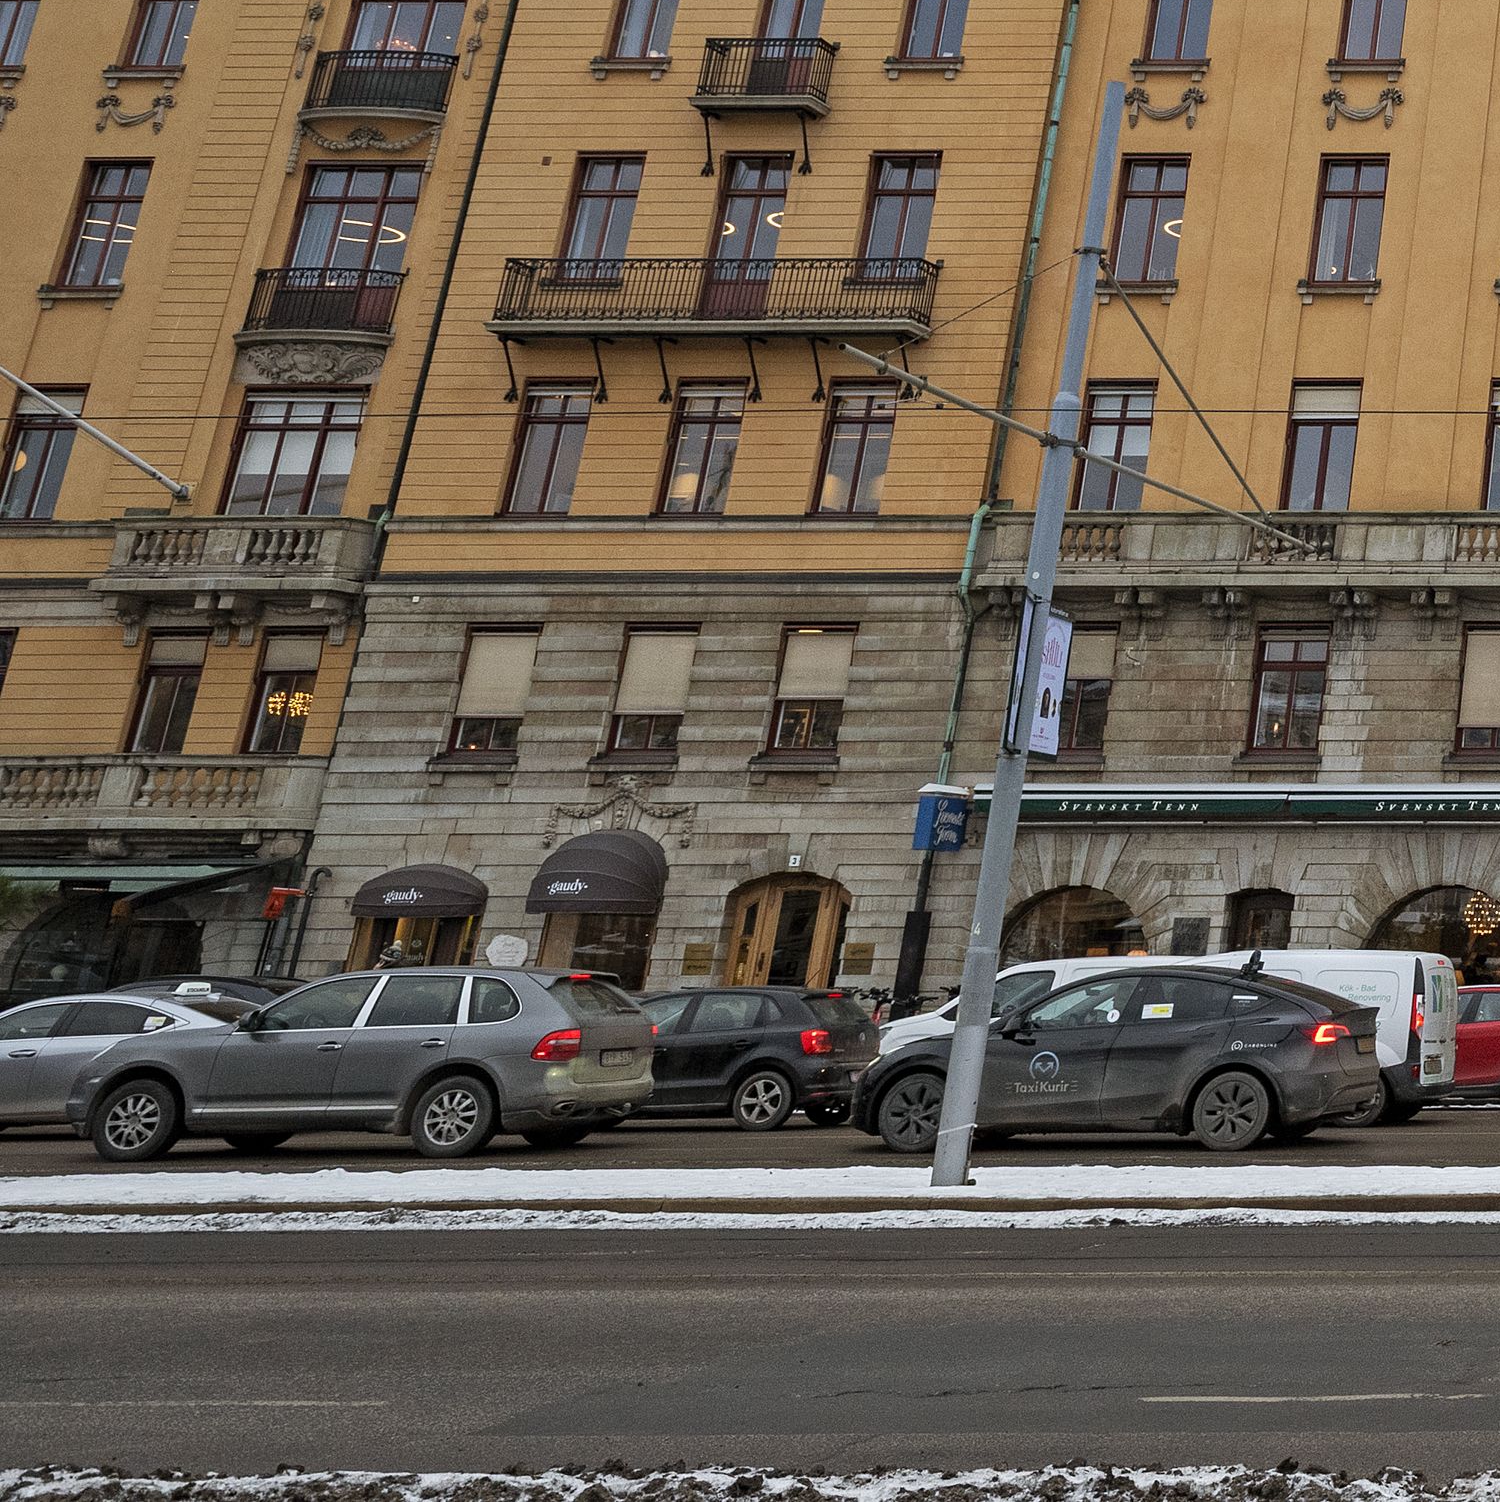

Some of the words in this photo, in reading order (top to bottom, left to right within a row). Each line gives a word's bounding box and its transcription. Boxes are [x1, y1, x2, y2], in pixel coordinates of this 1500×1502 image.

[1058, 801, 1142, 811] SVENSKT
[1151, 800, 1200, 810] TENN
[1375, 801, 1459, 811] SVENSKT
[1361, 984, 1377, 992] Bad
[1348, 993, 1391, 1003] Renovering
